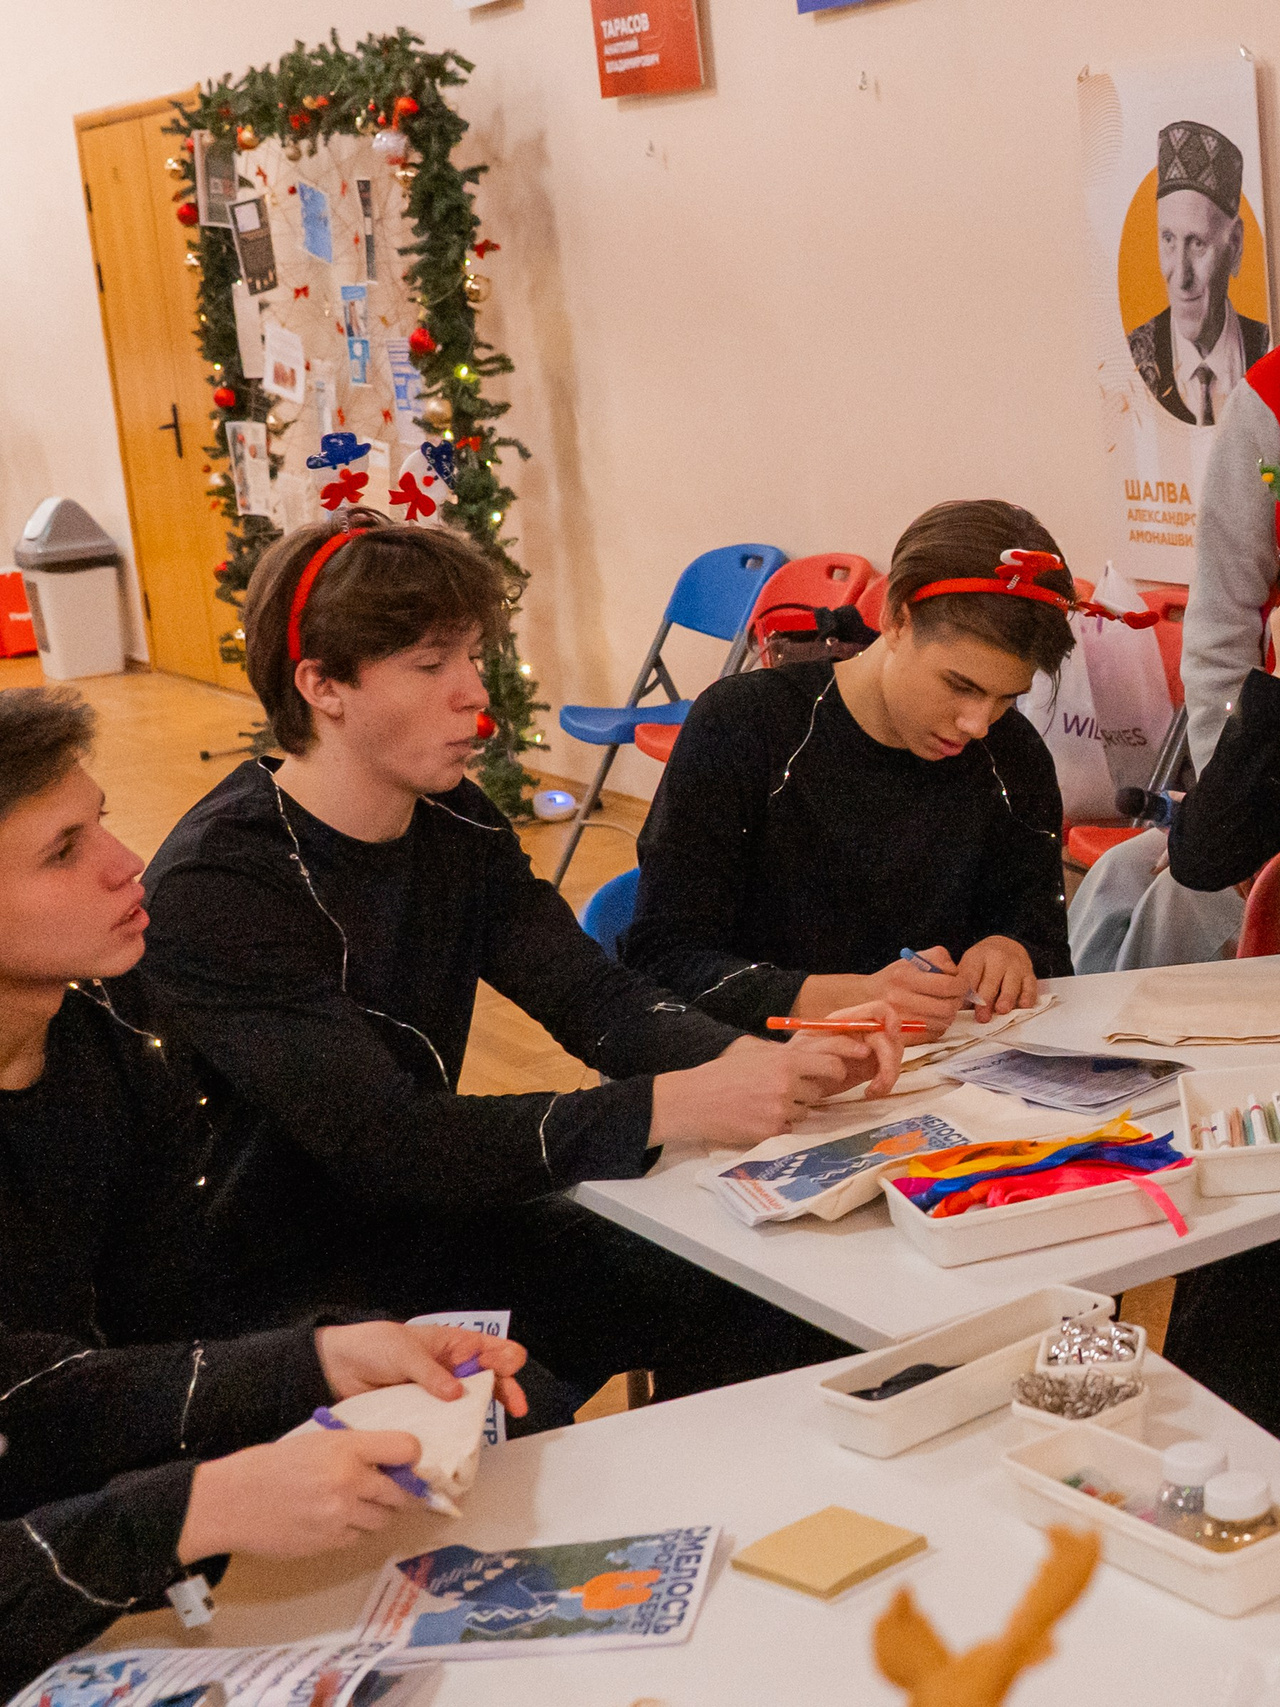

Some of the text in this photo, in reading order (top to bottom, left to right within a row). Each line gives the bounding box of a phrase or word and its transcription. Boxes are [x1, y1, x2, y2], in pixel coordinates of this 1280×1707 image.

[601, 12, 650, 39] ТАРАСОВ
[1124, 479, 1192, 505] ШАЛВА
[1129, 529, 1195, 548] АМОНАШВИ
